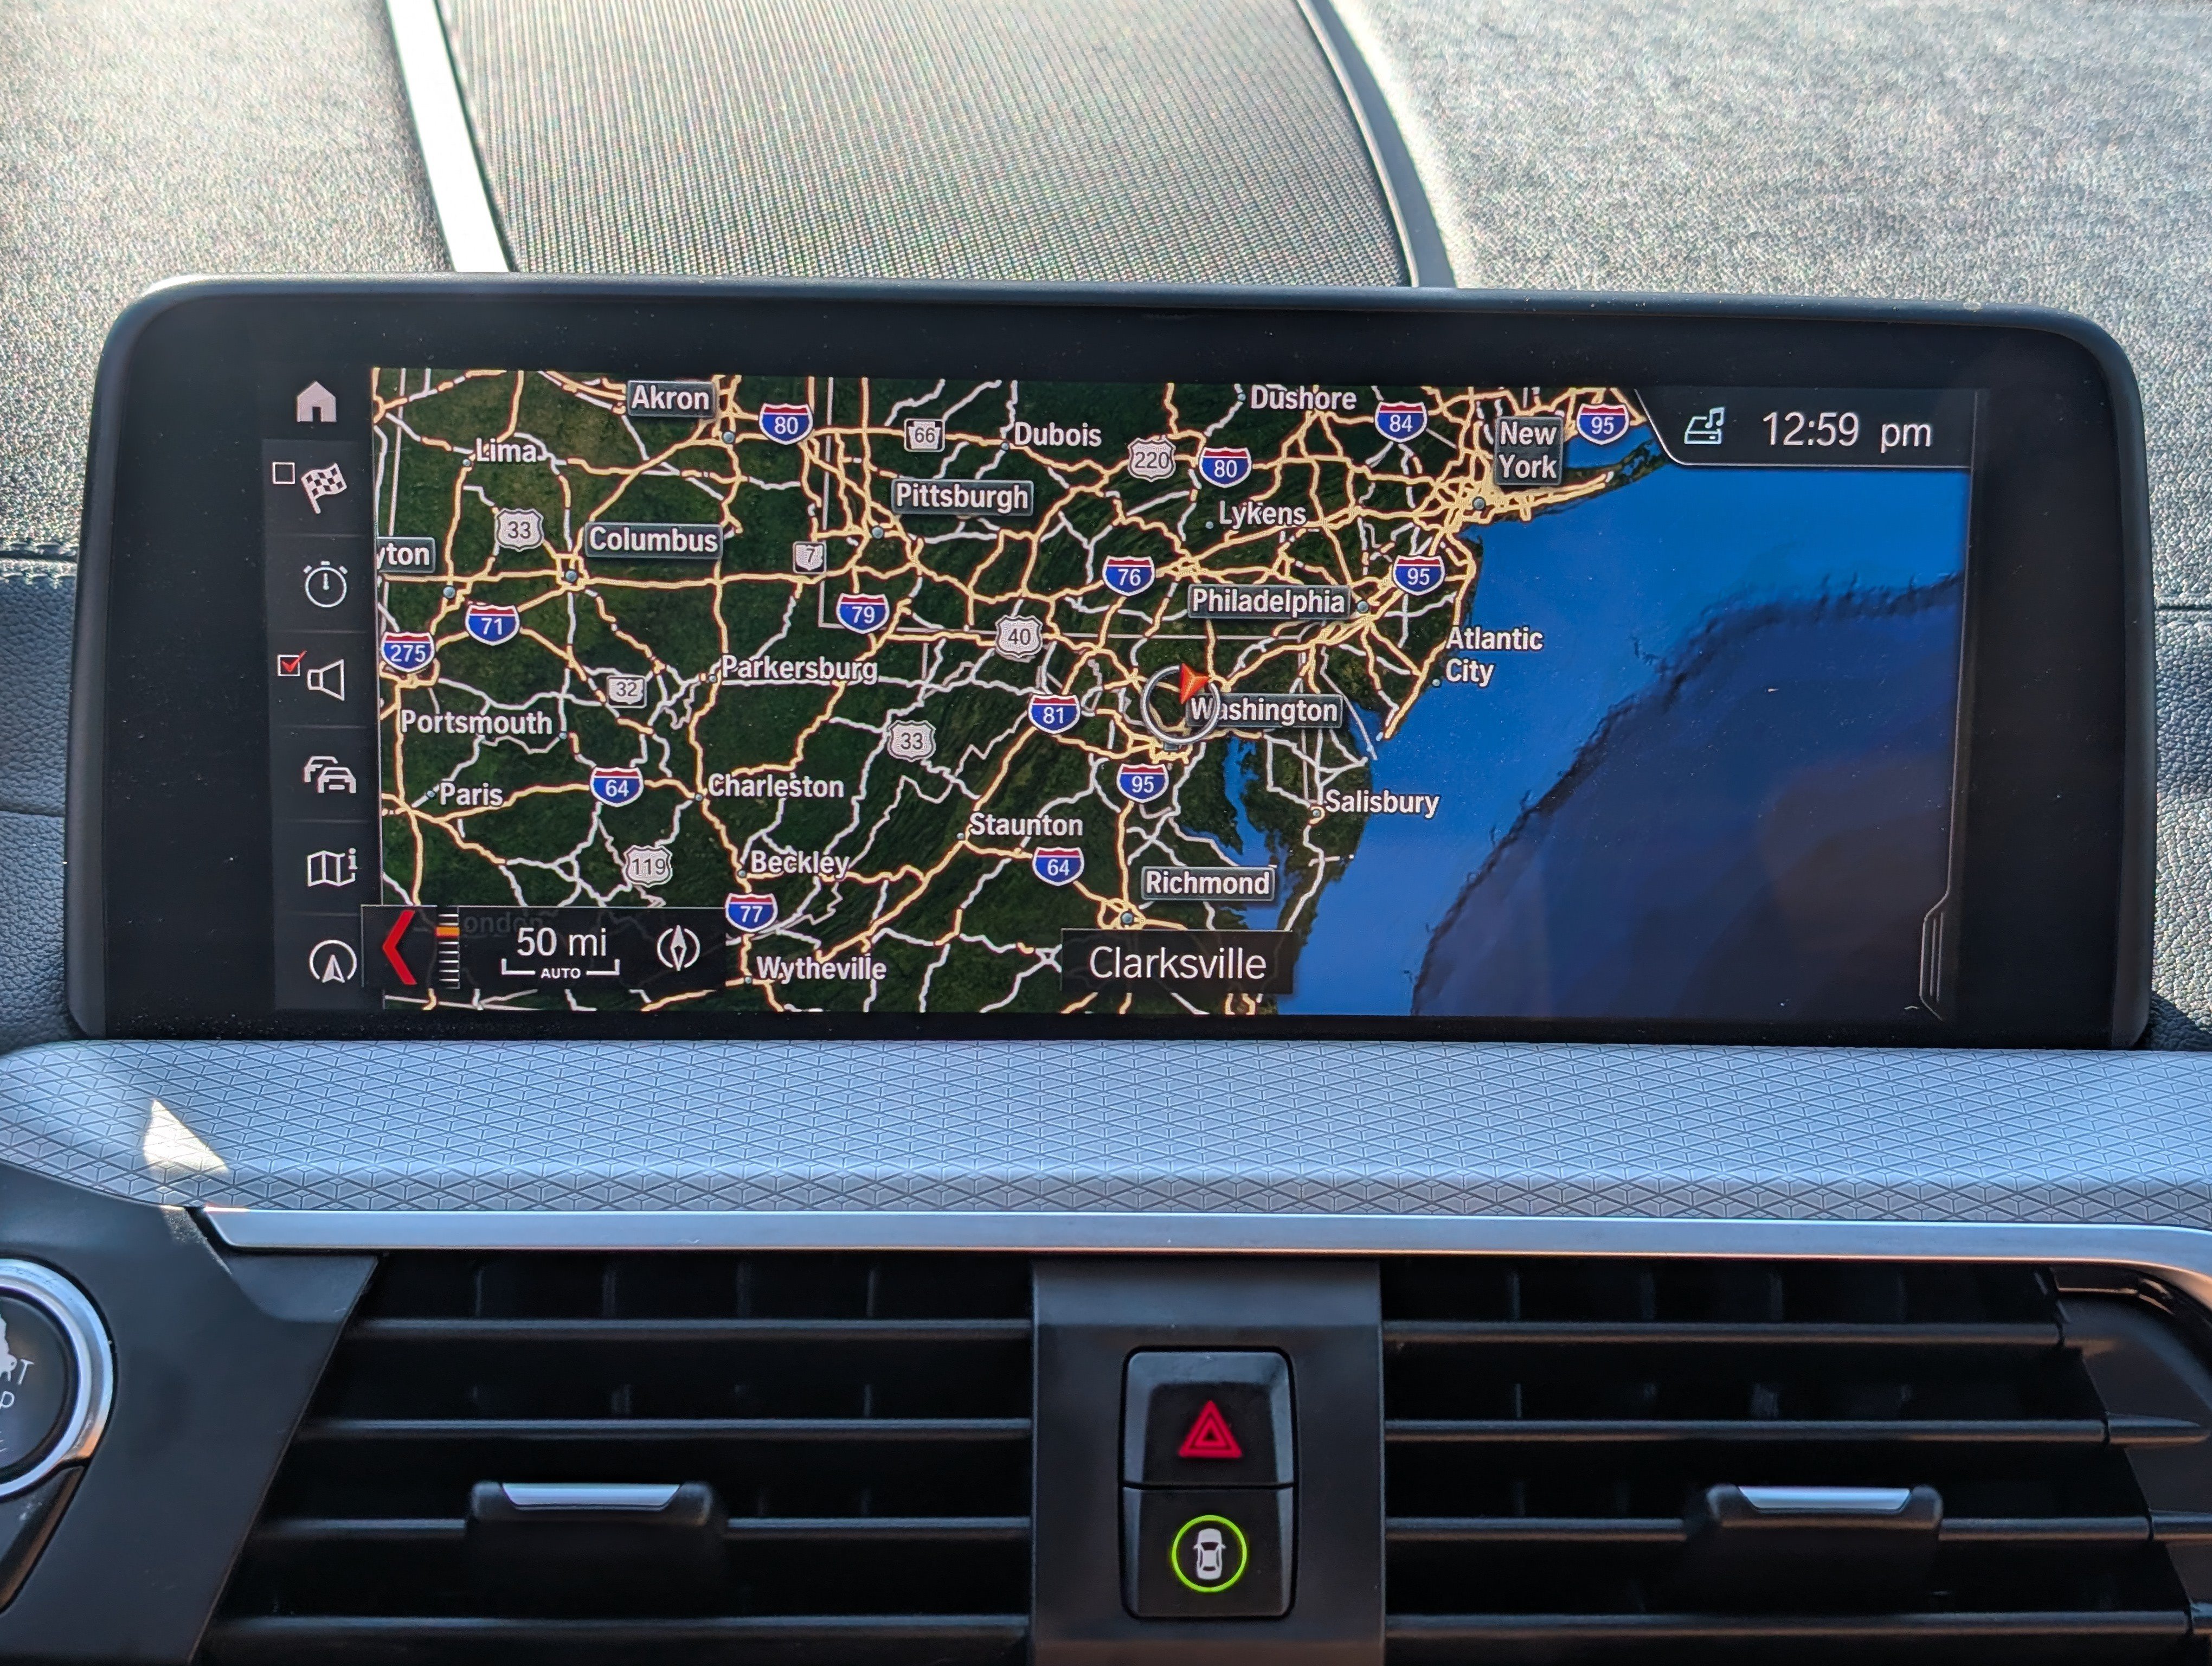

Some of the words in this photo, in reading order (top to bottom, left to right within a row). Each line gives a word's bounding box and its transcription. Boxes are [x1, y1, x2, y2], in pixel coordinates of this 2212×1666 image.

[632, 385, 709, 410] Akron
[1251, 385, 1356, 409] Dushore
[775, 416, 799, 434] 80
[915, 427, 935, 443] 66
[1014, 422, 1102, 447] Dubois
[1389, 414, 1413, 433] 84
[1500, 422, 1555, 446] New
[1590, 416, 1614, 434] 95
[1763, 412, 1859, 446] 12:59
[1880, 422, 1932, 453] pm
[476, 439, 536, 463] Lima
[1135, 451, 1169, 469] 220
[1214, 459, 1238, 478] 80
[1499, 454, 1557, 478] York
[896, 483, 1028, 513] Pittsburgh
[1219, 499, 1307, 531] Lykens
[507, 521, 531, 539] 33
[590, 527, 718, 552] Columbus
[807, 548, 815, 563] 7
[1117, 568, 1141, 586] 76
[1406, 568, 1430, 586] 95
[1193, 588, 1345, 618] Philadelphia
[481, 617, 503, 635] 71
[851, 606, 876, 625] 79
[1008, 630, 1032, 648] 40
[1446, 627, 1544, 650] Atlantic
[389, 645, 426, 663] 275
[722, 655, 878, 684] Parkersburg
[1445, 659, 1494, 687] City
[615, 681, 638, 697] 32
[401, 710, 553, 735] Portsmouth
[1043, 707, 1064, 725] 81
[899, 732, 923, 749] 33
[440, 782, 504, 806] Paris
[605, 779, 629, 797] 64
[708, 773, 844, 798] Charleston
[1131, 775, 1154, 793] 95
[1325, 790, 1439, 819] Salisbury
[970, 812, 1083, 837] Staunton
[631, 857, 667, 876] 119
[751, 850, 850, 879] Beckley
[1046, 858, 1071, 877] 64
[1146, 870, 1270, 895] Richmond
[740, 906, 763, 924] 77
[517, 927, 557, 956] 50
[569, 927, 606, 956] mi
[541, 967, 580, 978] AUTO
[756, 955, 887, 984] Wytheville
[1089, 946, 1267, 979] Clarksville
